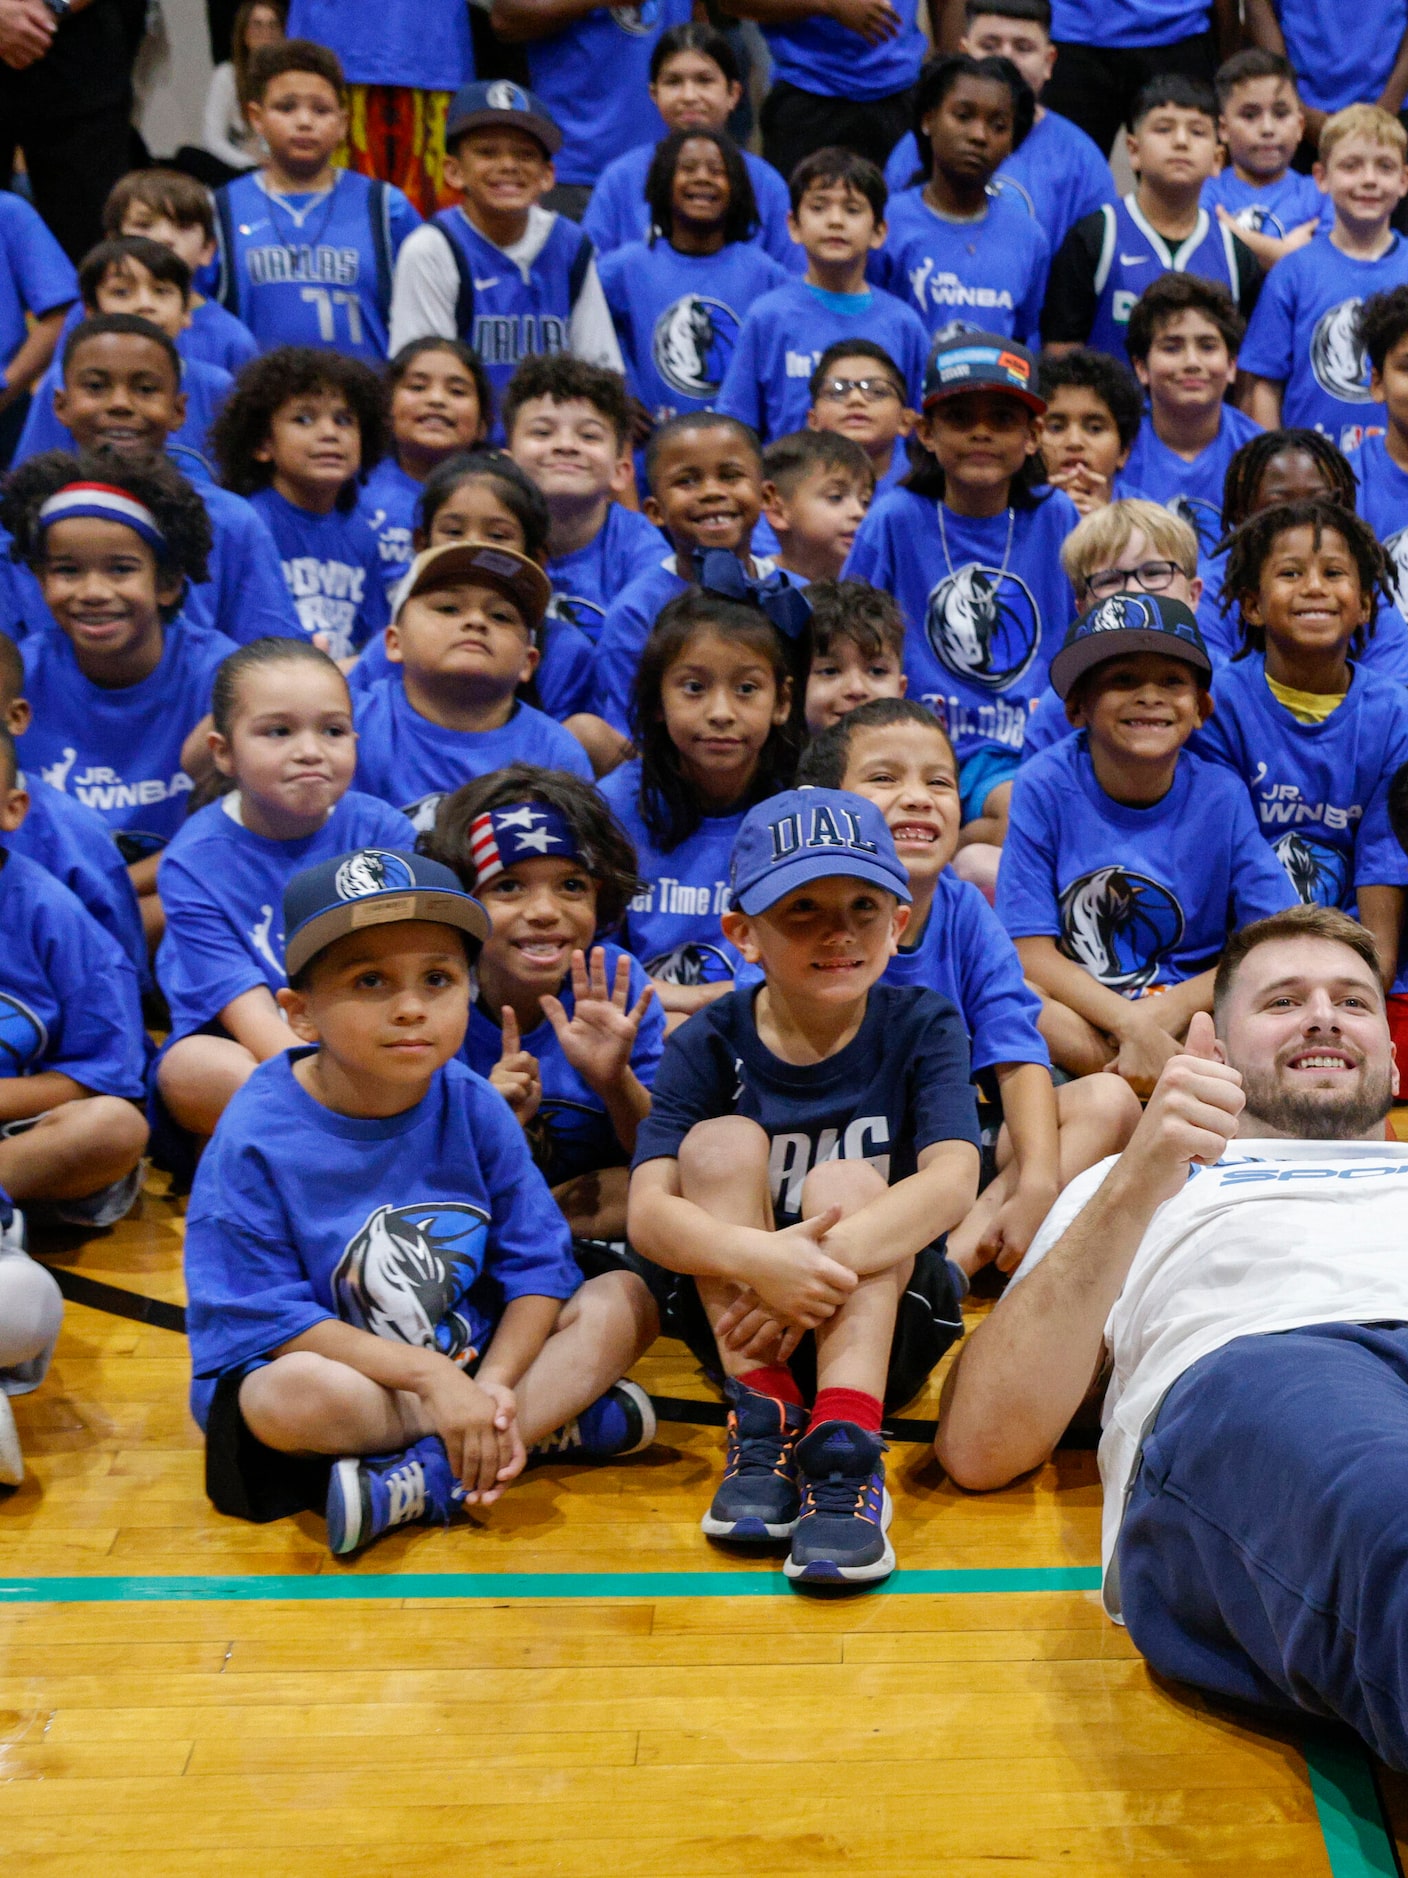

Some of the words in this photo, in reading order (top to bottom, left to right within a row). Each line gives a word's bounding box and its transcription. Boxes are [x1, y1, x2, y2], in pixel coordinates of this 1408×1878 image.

[245, 243, 360, 287] DALLAS
[301, 287, 363, 345] 77
[931, 286, 1013, 310] WNBA
[473, 314, 573, 365] DALLA
[73, 766, 122, 785] JR.
[75, 772, 196, 810] WNBA
[1261, 783, 1303, 801] JR.
[768, 806, 879, 864] DAL
[658, 877, 711, 916] Time
